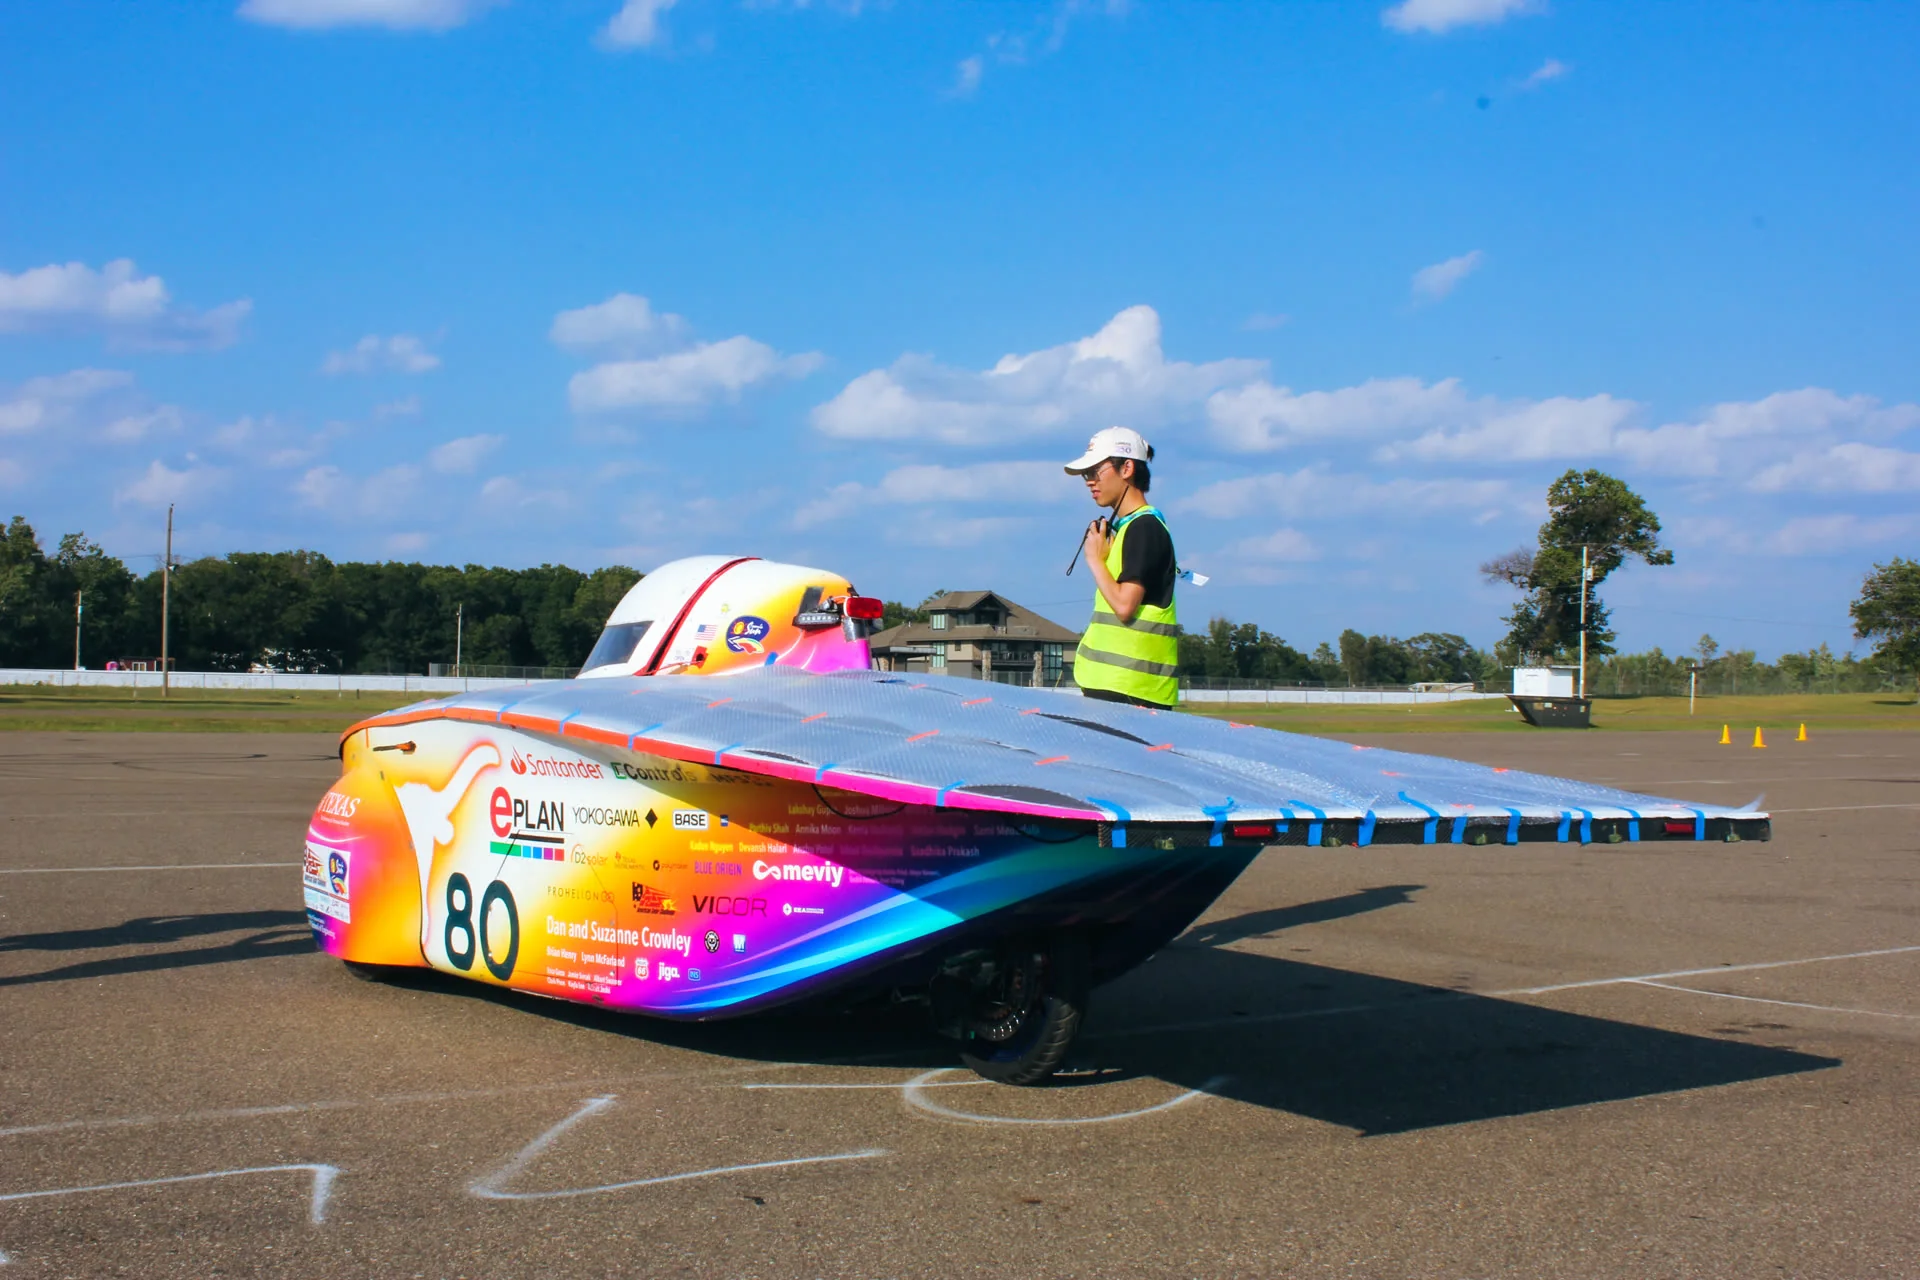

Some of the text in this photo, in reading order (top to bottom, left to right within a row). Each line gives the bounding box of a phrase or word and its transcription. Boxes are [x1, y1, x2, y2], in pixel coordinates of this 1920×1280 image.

[526, 753, 604, 779] Santander
[318, 791, 360, 817] TEXAS
[572, 807, 640, 828] YOKOGAWA
[674, 813, 706, 827] BASE
[694, 861, 742, 876] BLUE ORIGIN
[783, 860, 844, 887] meviy
[547, 886, 599, 901] PROHELION
[692, 895, 767, 917] VICOR
[445, 872, 520, 981] 80
[546, 915, 691, 957] Dan and Suzanne Crowley
[581, 951, 625, 967] Lynn McFarland
